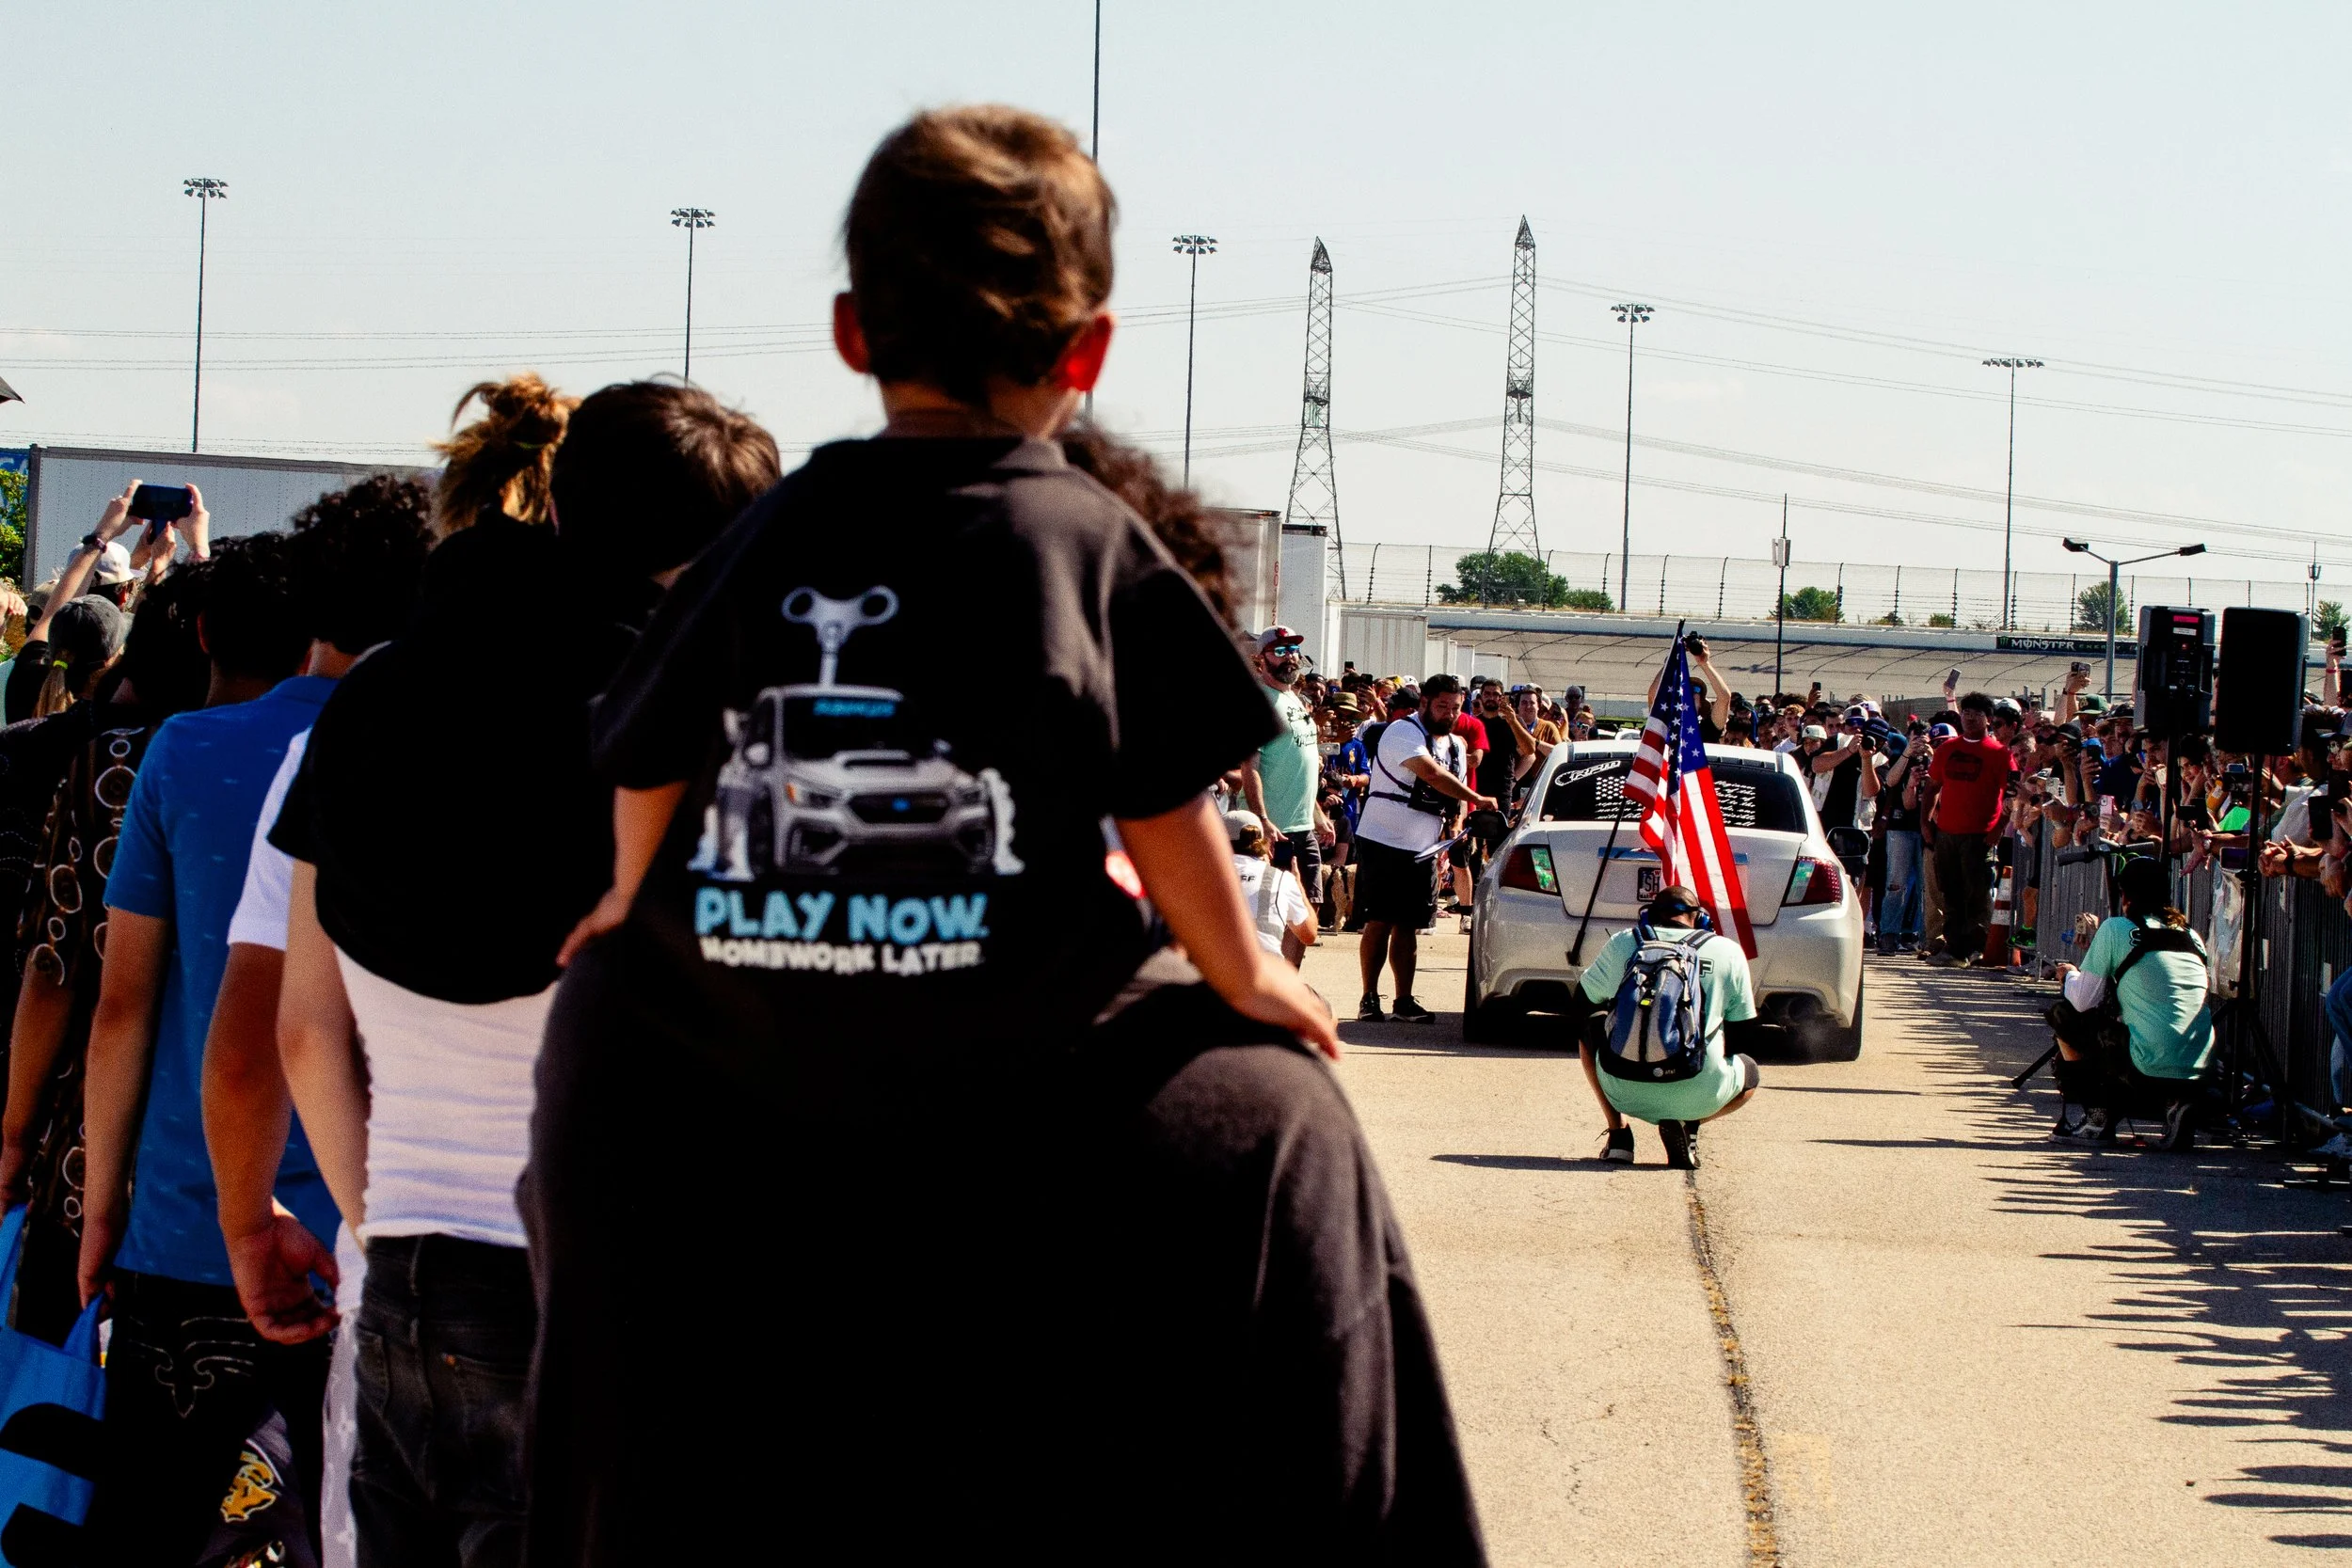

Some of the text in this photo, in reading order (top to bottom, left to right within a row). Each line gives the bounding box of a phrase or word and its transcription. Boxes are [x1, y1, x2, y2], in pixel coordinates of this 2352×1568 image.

[2011, 638, 2075, 651] MONSTER
[694, 887, 989, 944] PLAY NOW.
[700, 936, 876, 974] HOMEWORK
